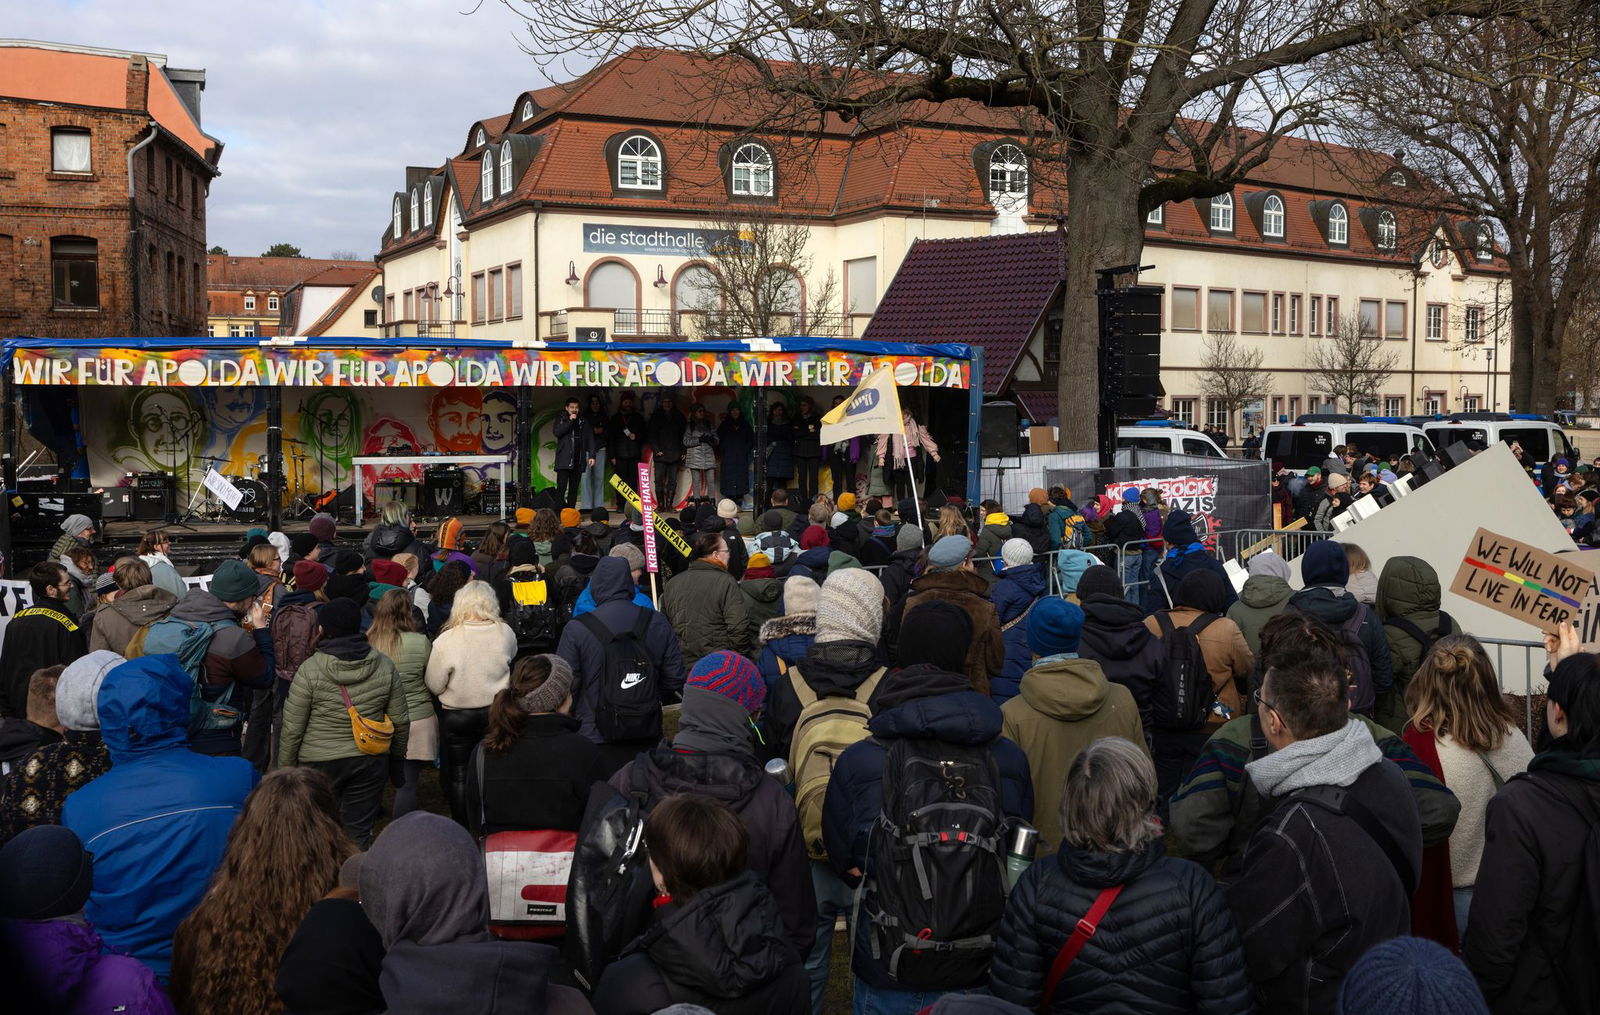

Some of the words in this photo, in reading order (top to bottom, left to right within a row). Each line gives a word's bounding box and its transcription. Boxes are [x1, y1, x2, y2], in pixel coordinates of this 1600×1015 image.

[589, 228, 616, 244] die
[620, 231, 705, 248] stadthalle
[13, 357, 72, 385] WIR
[77, 357, 134, 385] FÜR
[140, 358, 260, 386] APOLDA
[265, 359, 323, 386] WIR
[332, 359, 387, 386] FÜR
[392, 360, 504, 387] APOLDA
[509, 360, 563, 387] WIR
[569, 360, 621, 387] FÜR
[623, 361, 729, 387] APOLDA
[739, 361, 793, 387] WIR
[801, 361, 850, 387] FÜR
[640, 468, 652, 503] HAKEN
[1159, 480, 1213, 498] BOCK
[643, 505, 654, 533] OHNE
[654, 516, 689, 552] VIELFALT
[645, 534, 658, 568] KREUZ
[1477, 535, 1509, 564] WE
[1508, 547, 1542, 580] WILL
[1547, 564, 1589, 595] NOT
[1465, 568, 1509, 603] LIVE
[1510, 588, 1530, 611] IN
[1530, 594, 1569, 625] FEAR
